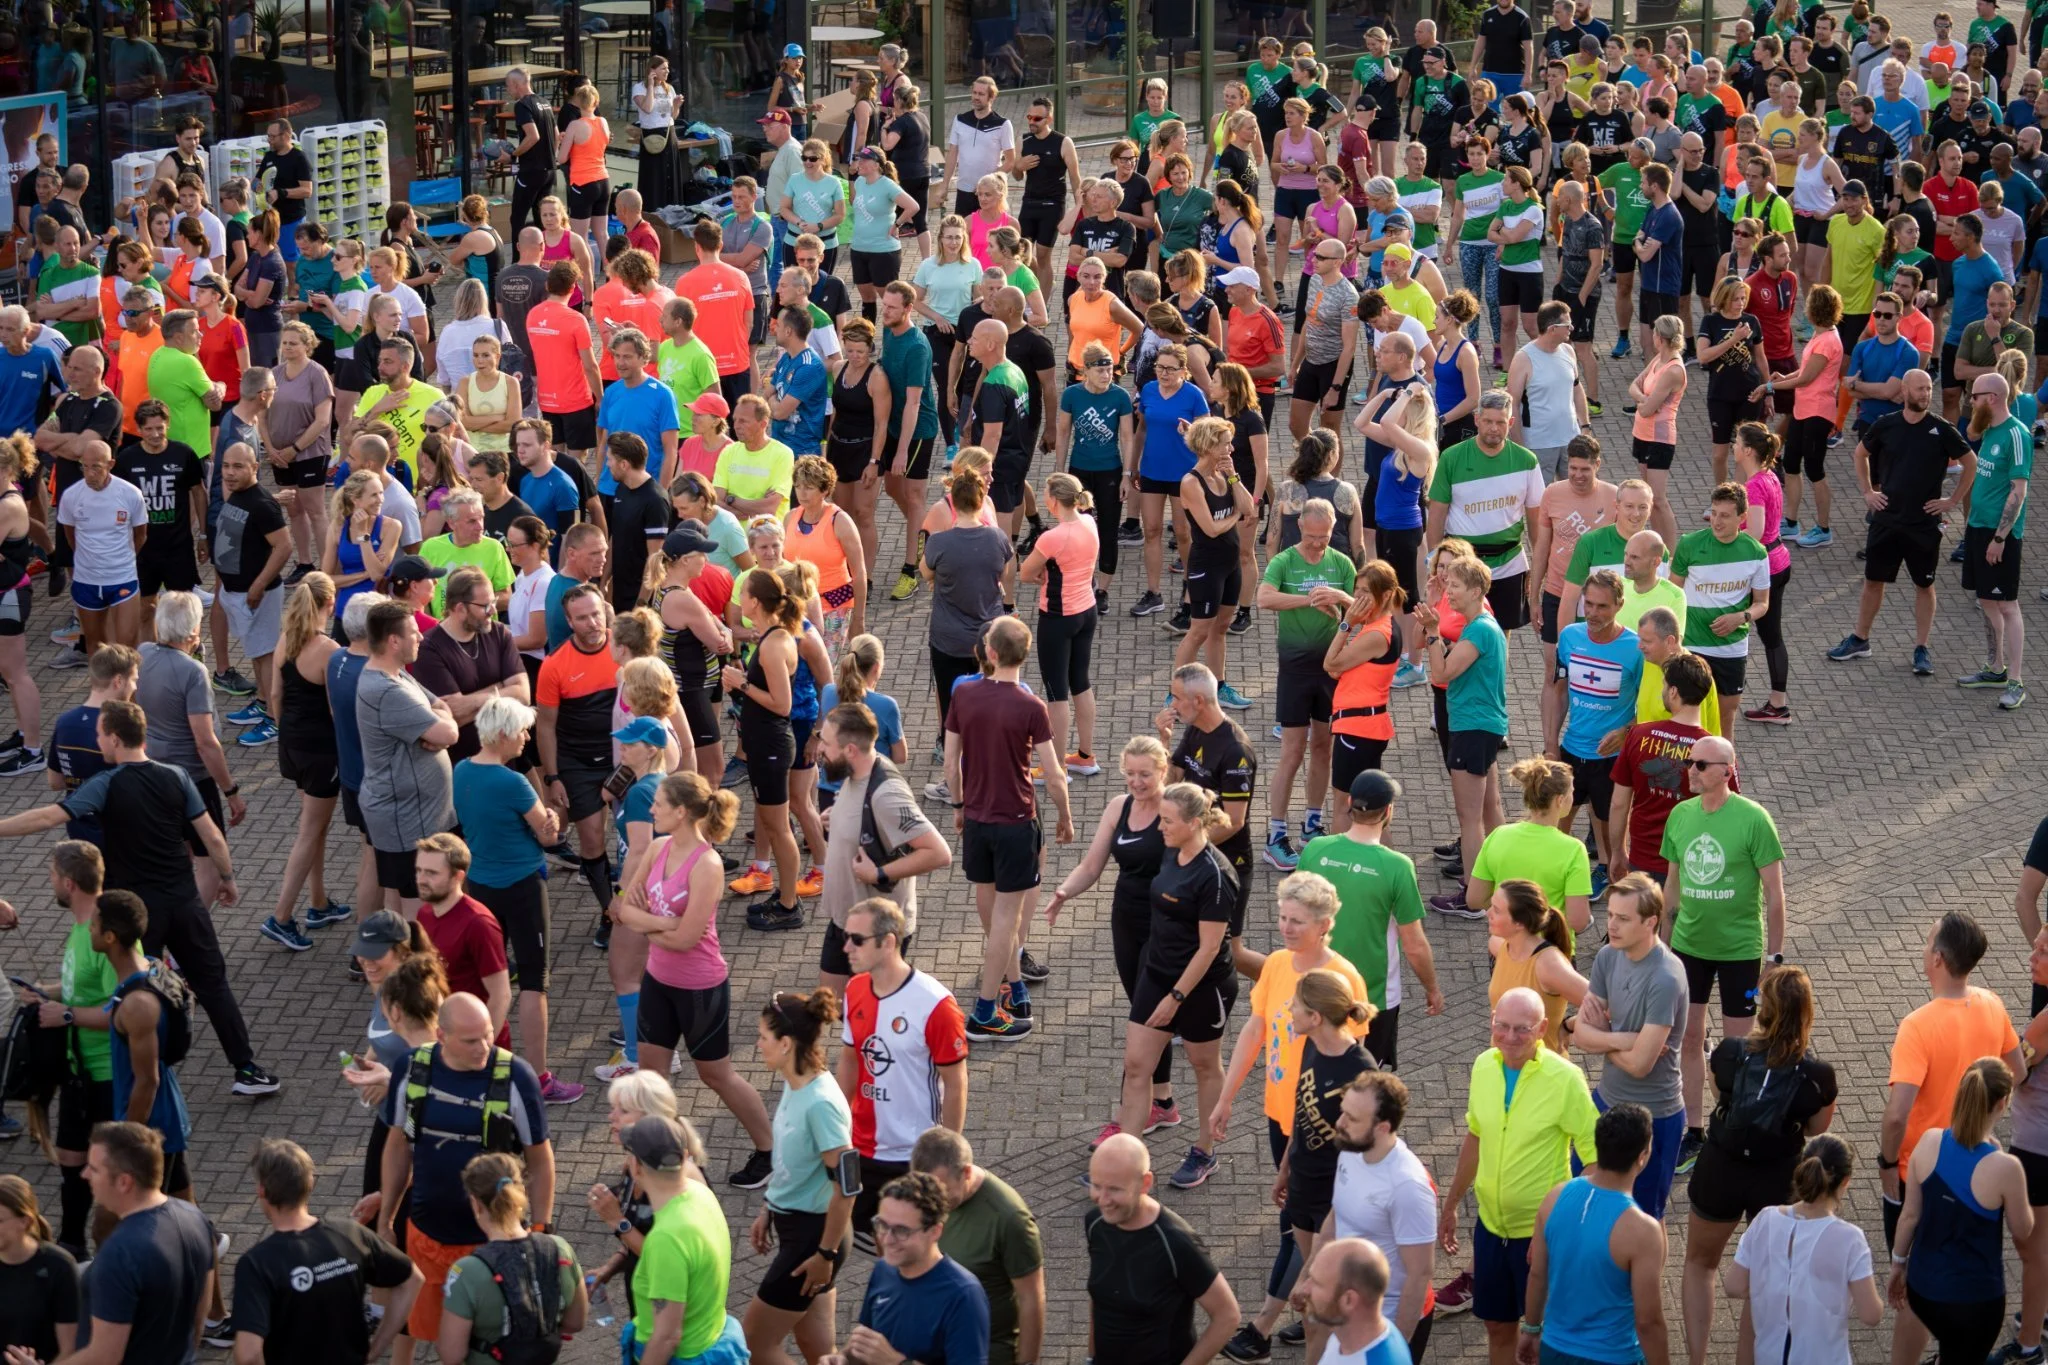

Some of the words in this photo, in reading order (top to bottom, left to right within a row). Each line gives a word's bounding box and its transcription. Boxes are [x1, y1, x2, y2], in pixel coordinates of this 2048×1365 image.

[1592, 127, 1615, 141] WE
[385, 408, 416, 449] R'dam
[1083, 405, 1115, 441] R'dam
[139, 475, 176, 498] WE
[144, 496, 176, 512] RUN
[1464, 496, 1518, 515] ROTTERDAM
[860, 1082, 892, 1103] OPEL
[1300, 1067, 1337, 1142] R'dam
[313, 1257, 347, 1273] nationale
[316, 1264, 360, 1282] nederlanden
